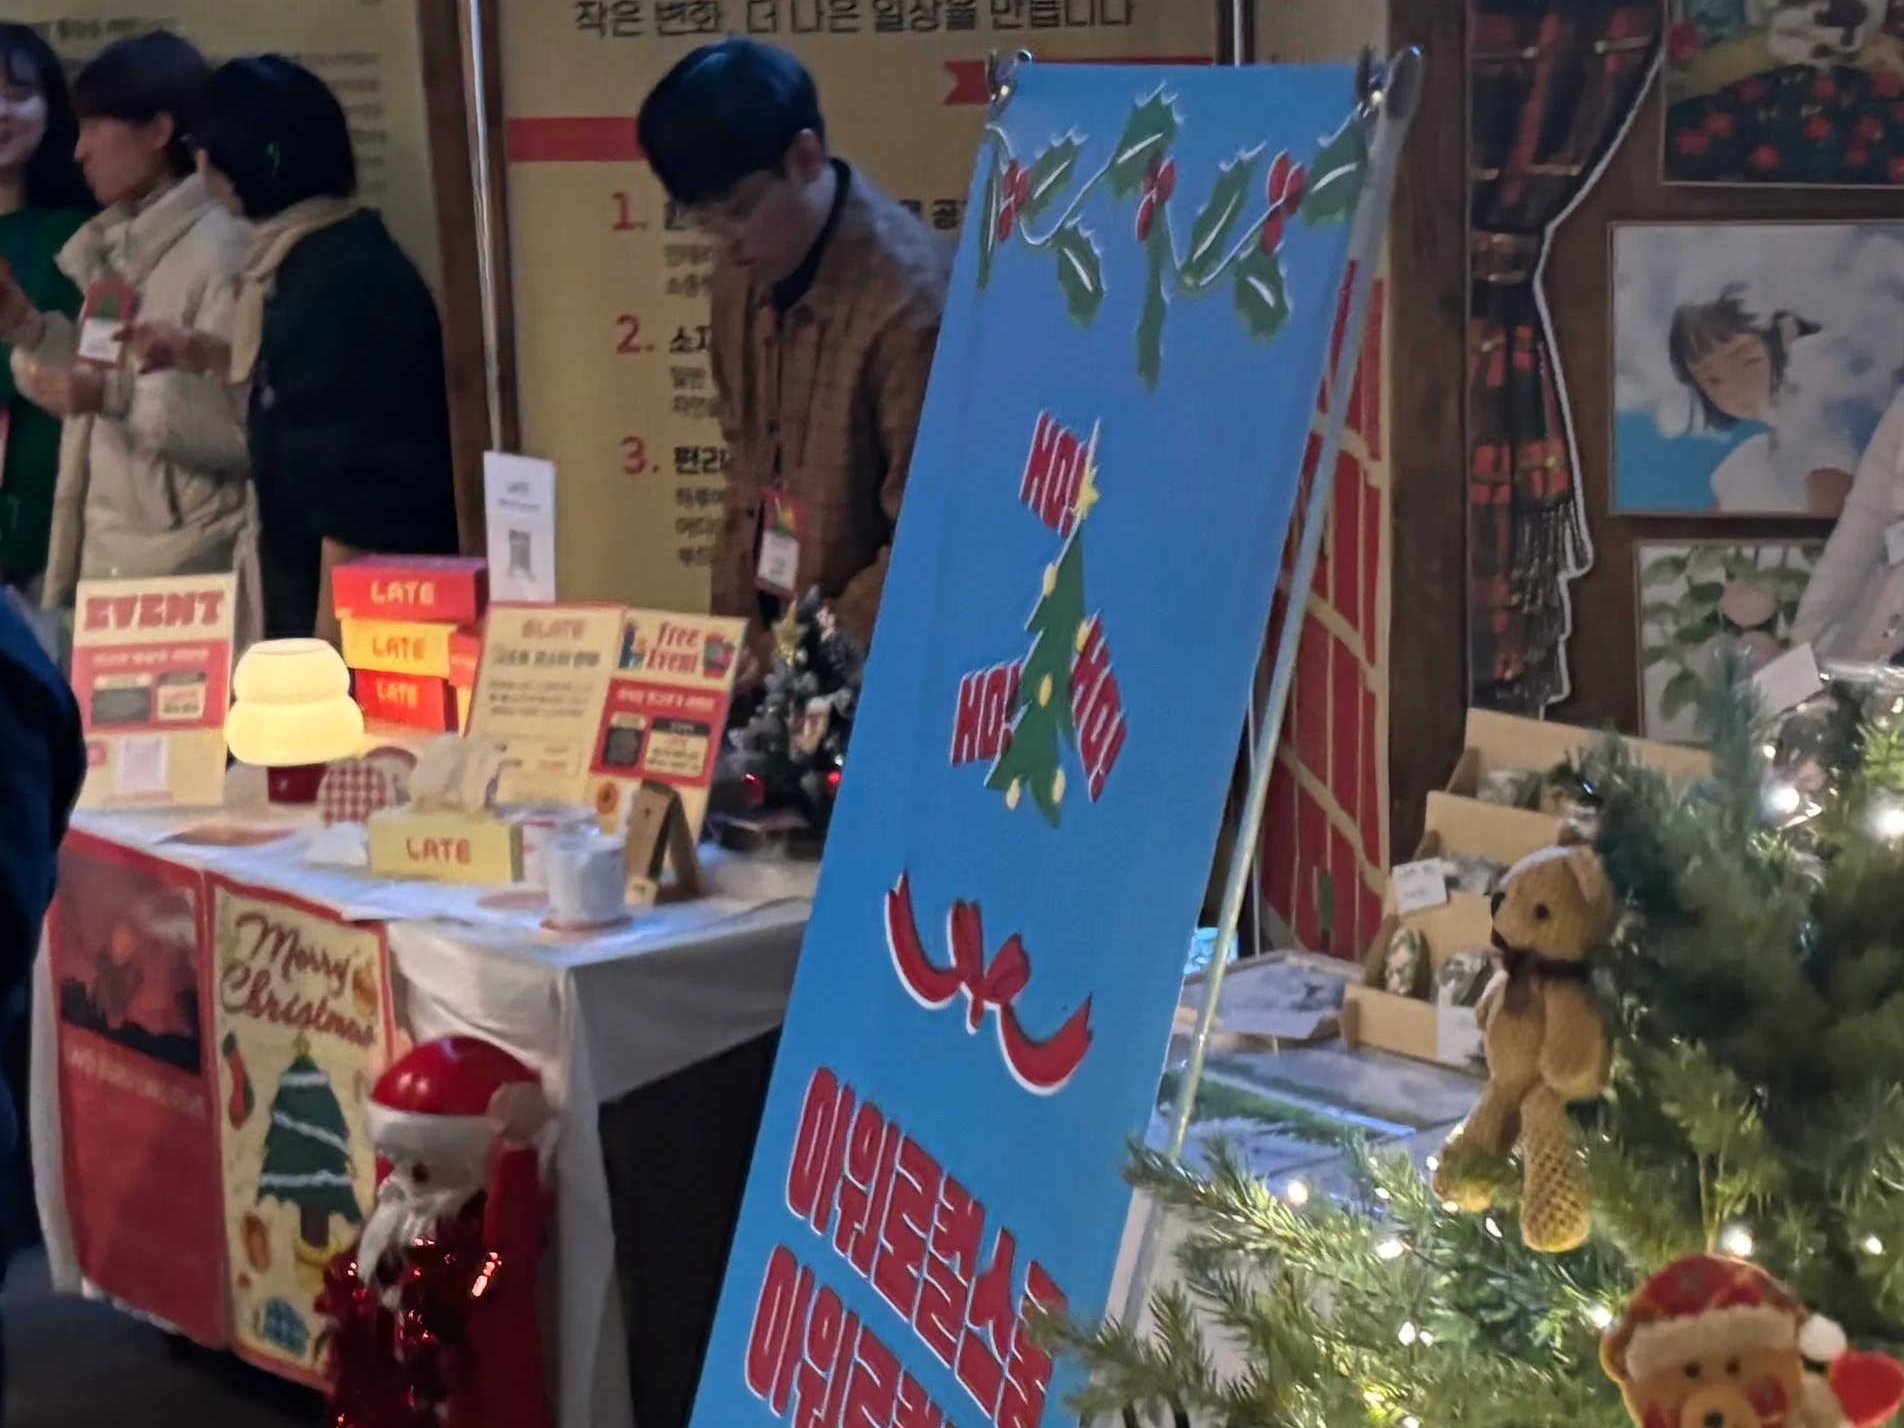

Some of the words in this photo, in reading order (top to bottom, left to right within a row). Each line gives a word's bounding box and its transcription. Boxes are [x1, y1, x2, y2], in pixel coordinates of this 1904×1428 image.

[610, 190, 648, 233] 1.
[616, 313, 655, 355] 2.
[619, 435, 660, 477] 3.
[84, 590, 226, 632] EVENT
[370, 580, 435, 607] LATE
[372, 636, 425, 663] LATE
[376, 680, 420, 708] LATE
[406, 836, 472, 866] LATE
[234, 909, 352, 998] Merry
[220, 959, 381, 1048] Christmas
